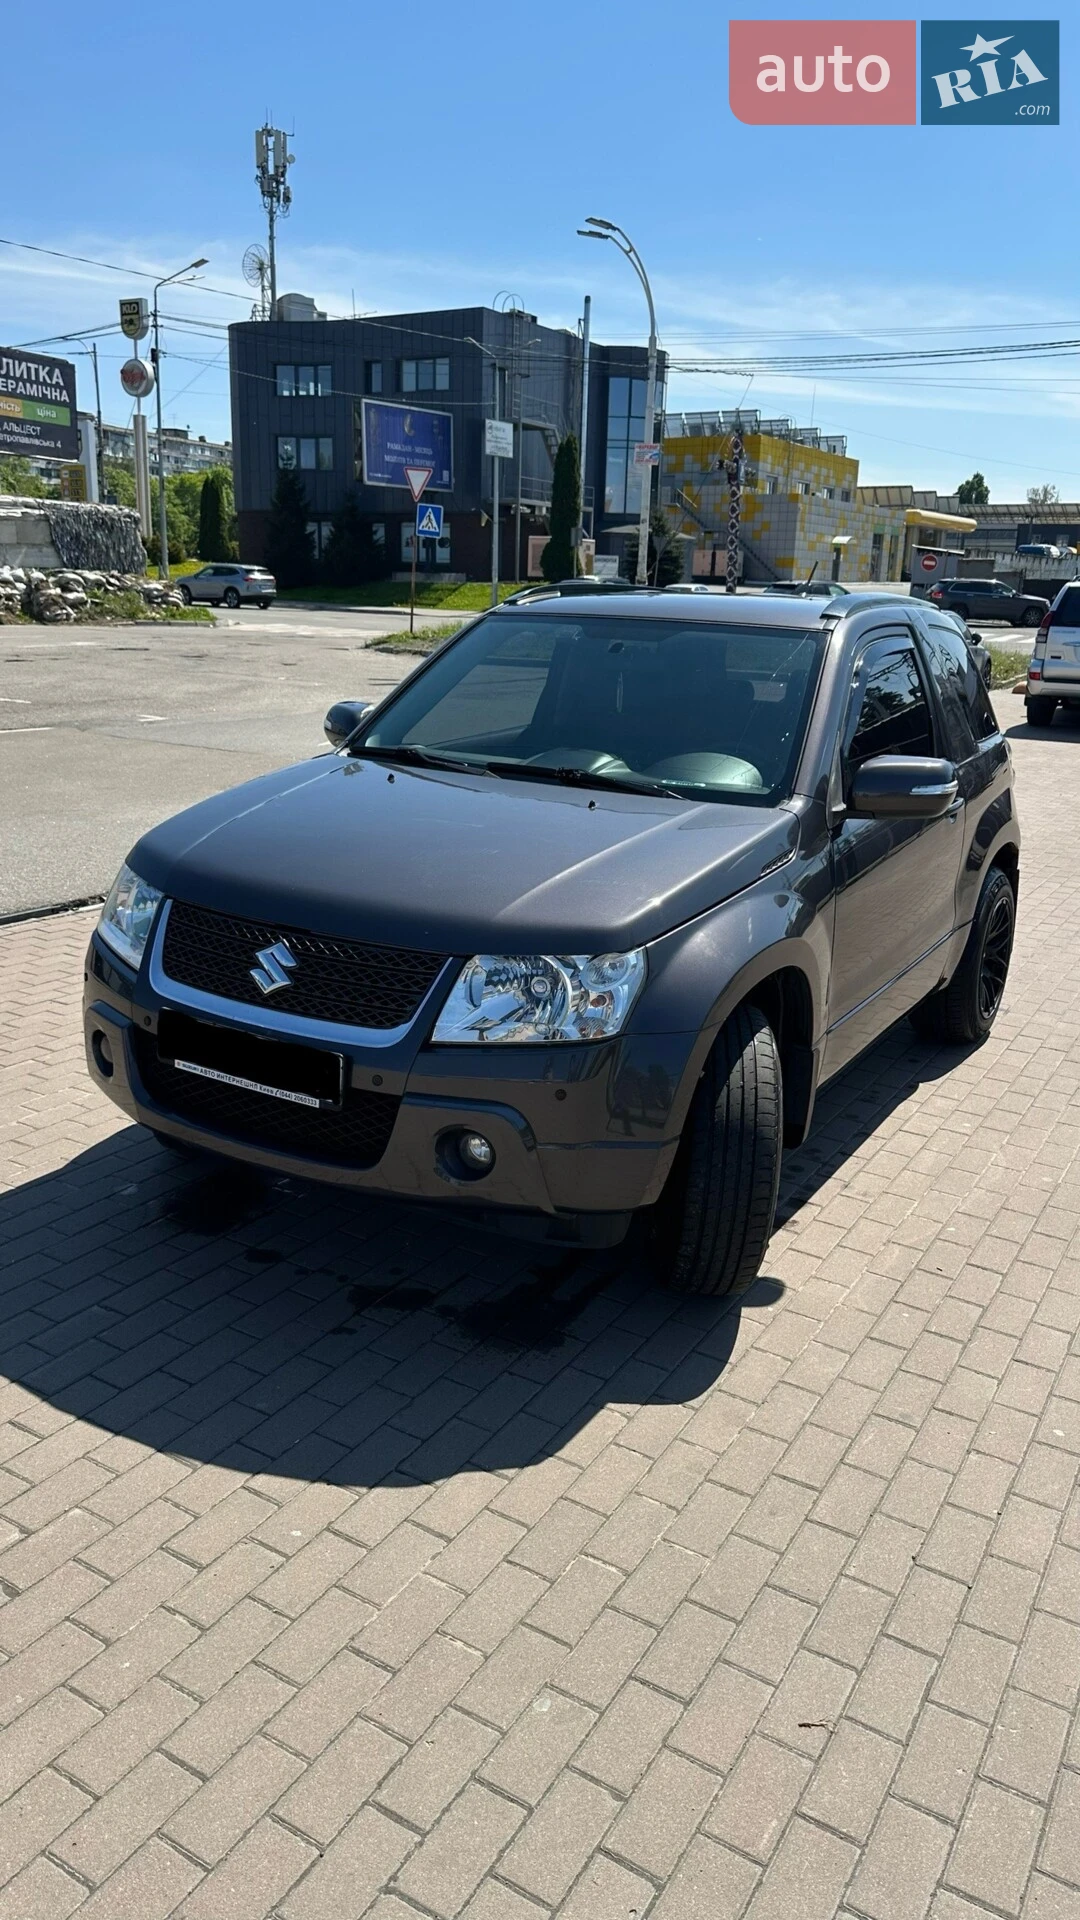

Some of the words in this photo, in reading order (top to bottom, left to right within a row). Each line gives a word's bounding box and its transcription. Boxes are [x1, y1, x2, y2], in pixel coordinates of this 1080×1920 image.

[36, 406, 57, 418] ціна
[2, 421, 41, 436] АЛЬЦЕСТ
[56, 440, 62, 449] 4
[200, 1068, 216, 1078] АВТО
